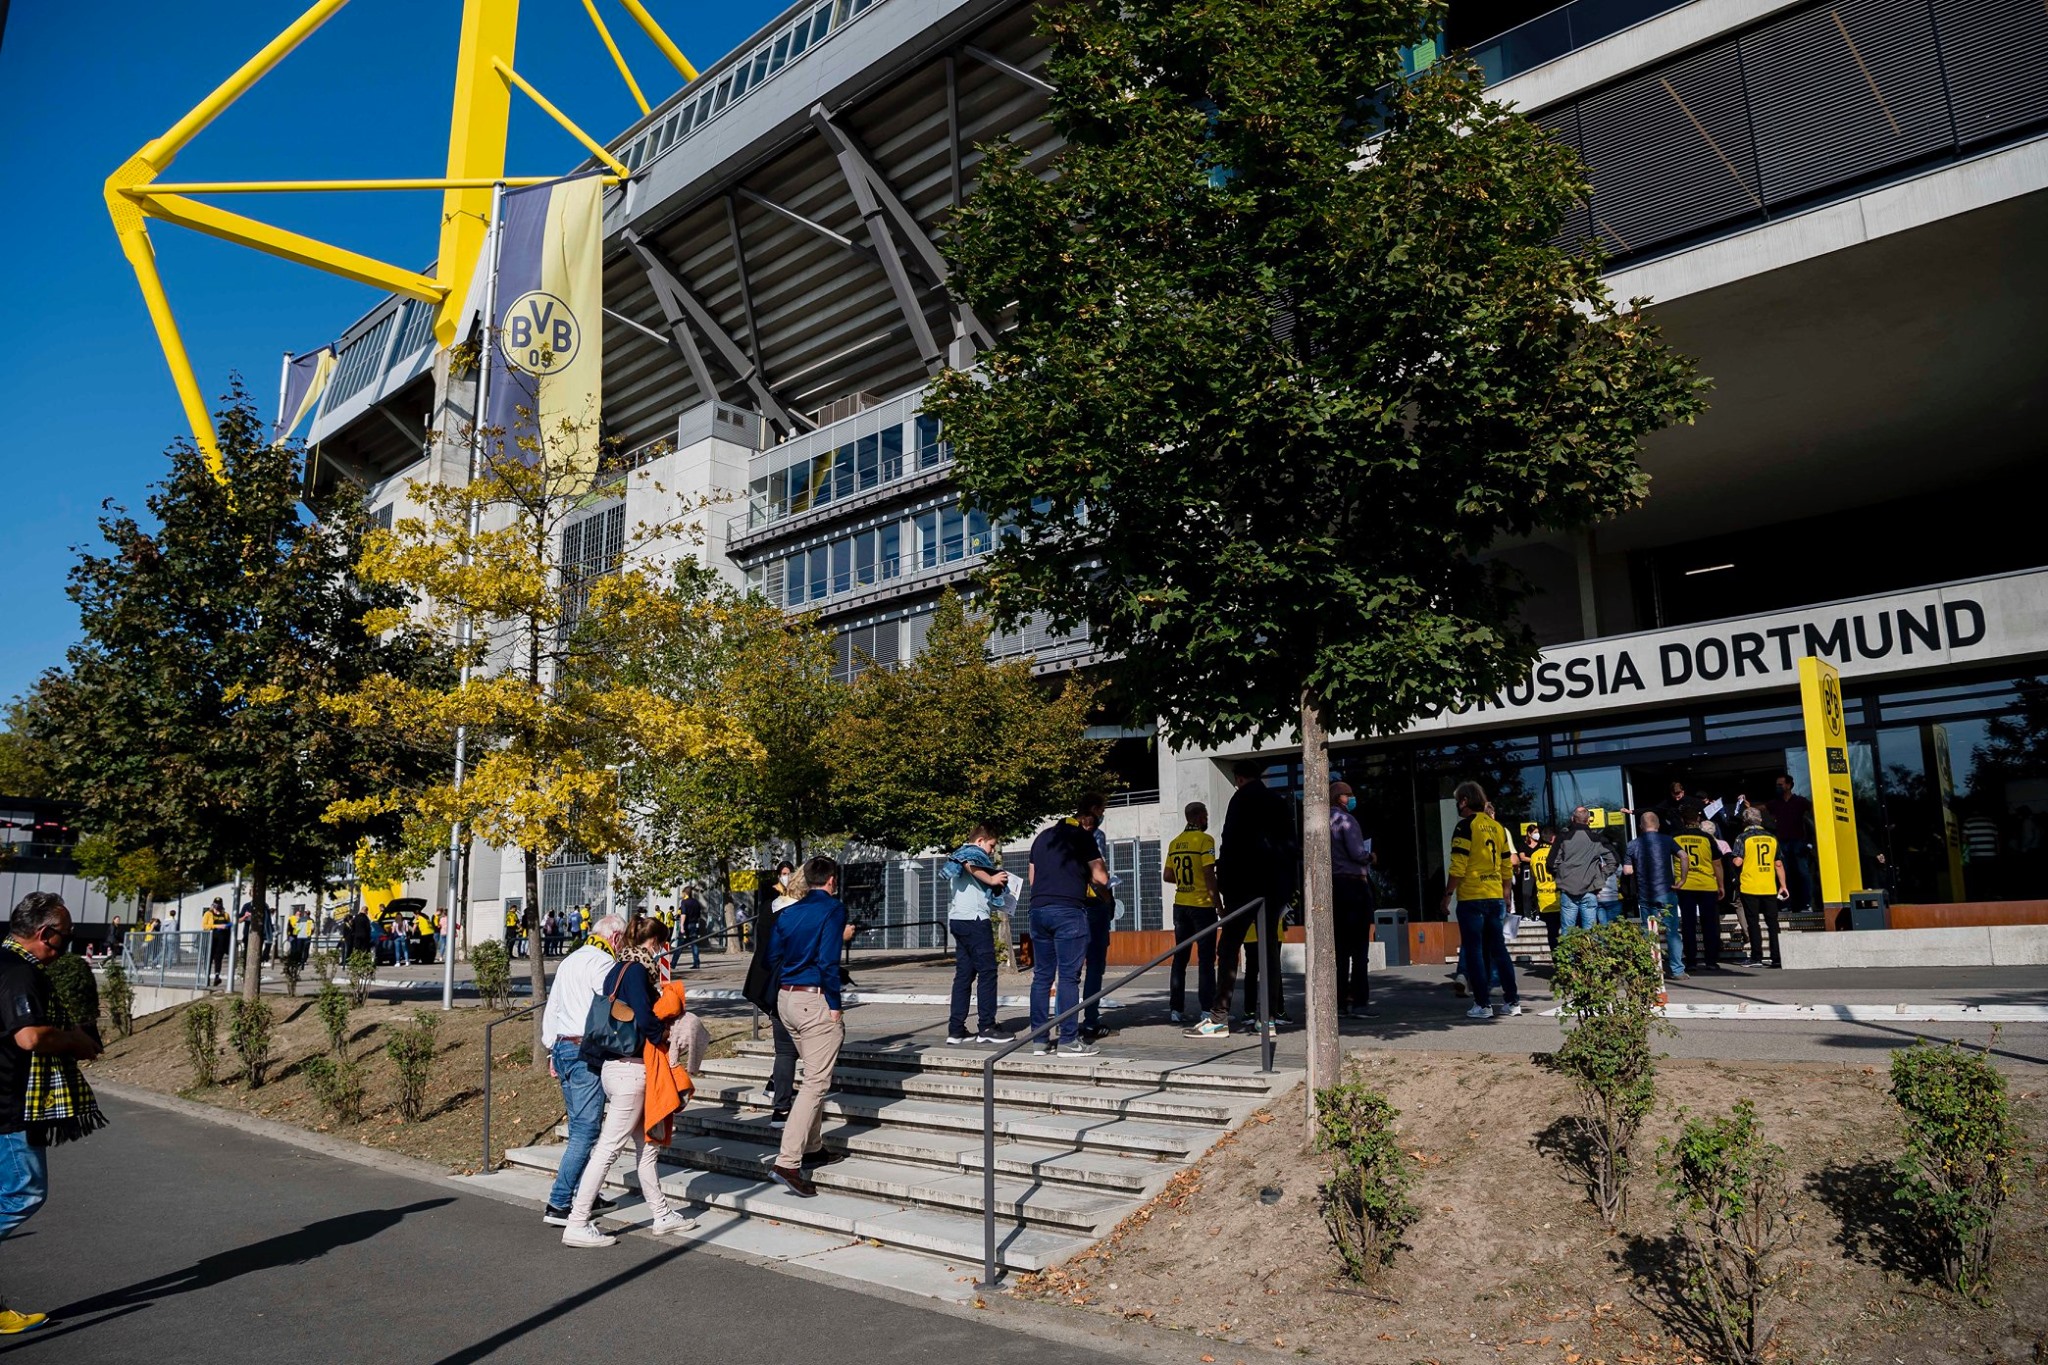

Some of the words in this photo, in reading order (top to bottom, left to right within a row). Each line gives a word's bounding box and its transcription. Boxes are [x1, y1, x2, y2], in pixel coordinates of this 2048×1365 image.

[511, 300, 572, 353] BVB
[1659, 599, 1986, 687] DORTMUND
[1825, 680, 1839, 719] BVB
[1173, 855, 1194, 886] 28
[1485, 839, 1496, 871] 7
[1756, 843, 1770, 866] 12
